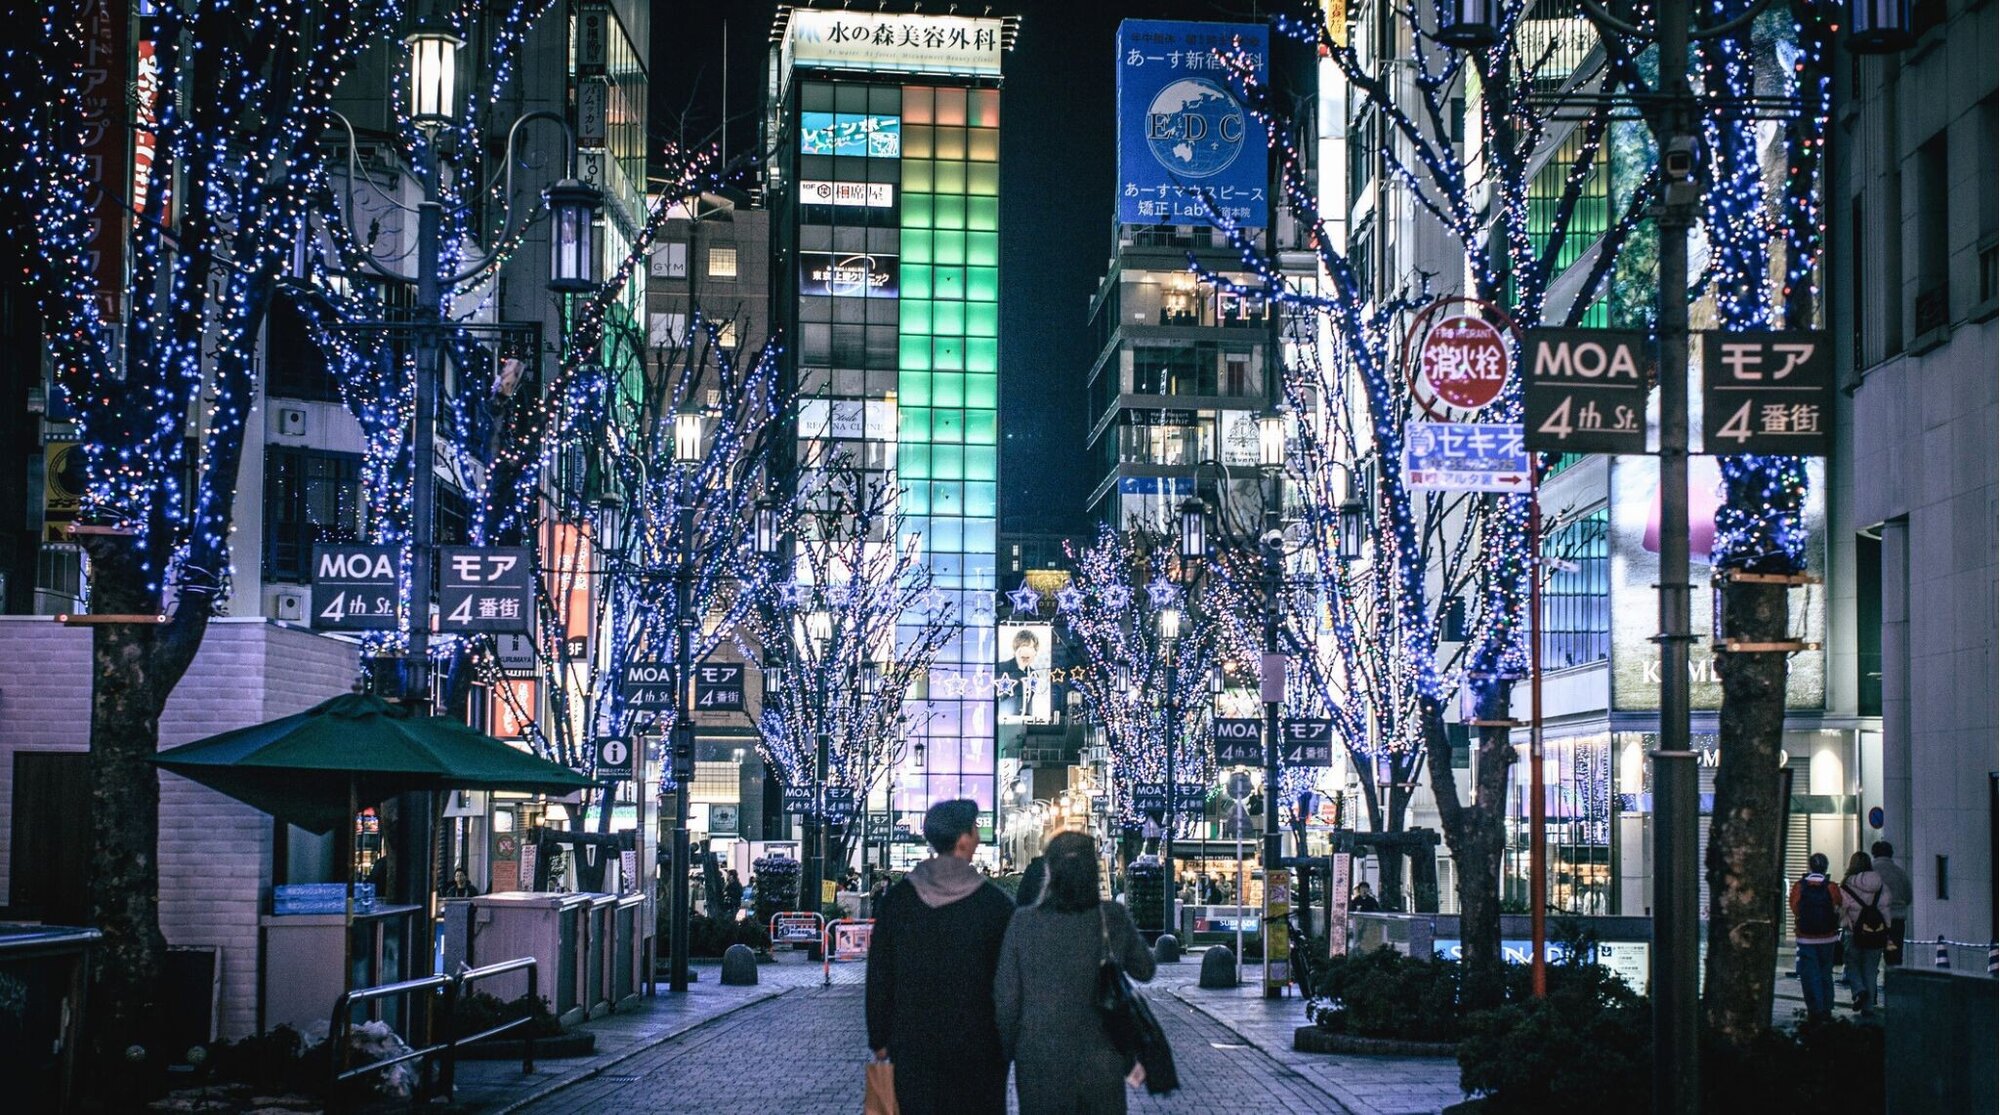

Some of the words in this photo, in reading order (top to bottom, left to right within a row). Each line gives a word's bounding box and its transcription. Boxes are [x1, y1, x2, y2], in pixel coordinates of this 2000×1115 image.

[827, 21, 997, 52] 水の森美容外科
[1126, 47, 1264, 72] あーす新宿科
[1124, 182, 1265, 201] あーすマウスピース
[1137, 200, 1169, 216] 矯正
[1173, 202, 1204, 217] Lab
[653, 262, 684, 272] GYM
[1425, 343, 1502, 380] 消火栓
[1533, 340, 1639, 380] MOA
[1720, 343, 1815, 381] モア
[1537, 395, 1602, 440] 4th
[1612, 405, 1639, 432] St.
[1715, 398, 1821, 444] 4番街
[1437, 426, 1526, 459] セキネ
[318, 554, 395, 579] MOA
[452, 555, 518, 582] モア
[320, 591, 367, 622] 4th
[375, 597, 394, 615] St.
[447, 594, 521, 625] 4番街
[628, 667, 671, 683] MOA
[701, 667, 738, 683] モア
[629, 688, 655, 706] 4th
[699, 689, 739, 707] 4番街
[1217, 723, 1259, 738] MOA
[1289, 723, 1327, 739] モア
[1221, 744, 1245, 762] 4th
[1288, 744, 1328, 763] 4番街
[785, 788, 811, 798] MOA
[829, 788, 851, 798] モア
[1136, 786, 1162, 795] MOA
[1179, 785, 1202, 795] モア
[872, 816, 889, 824] モア
